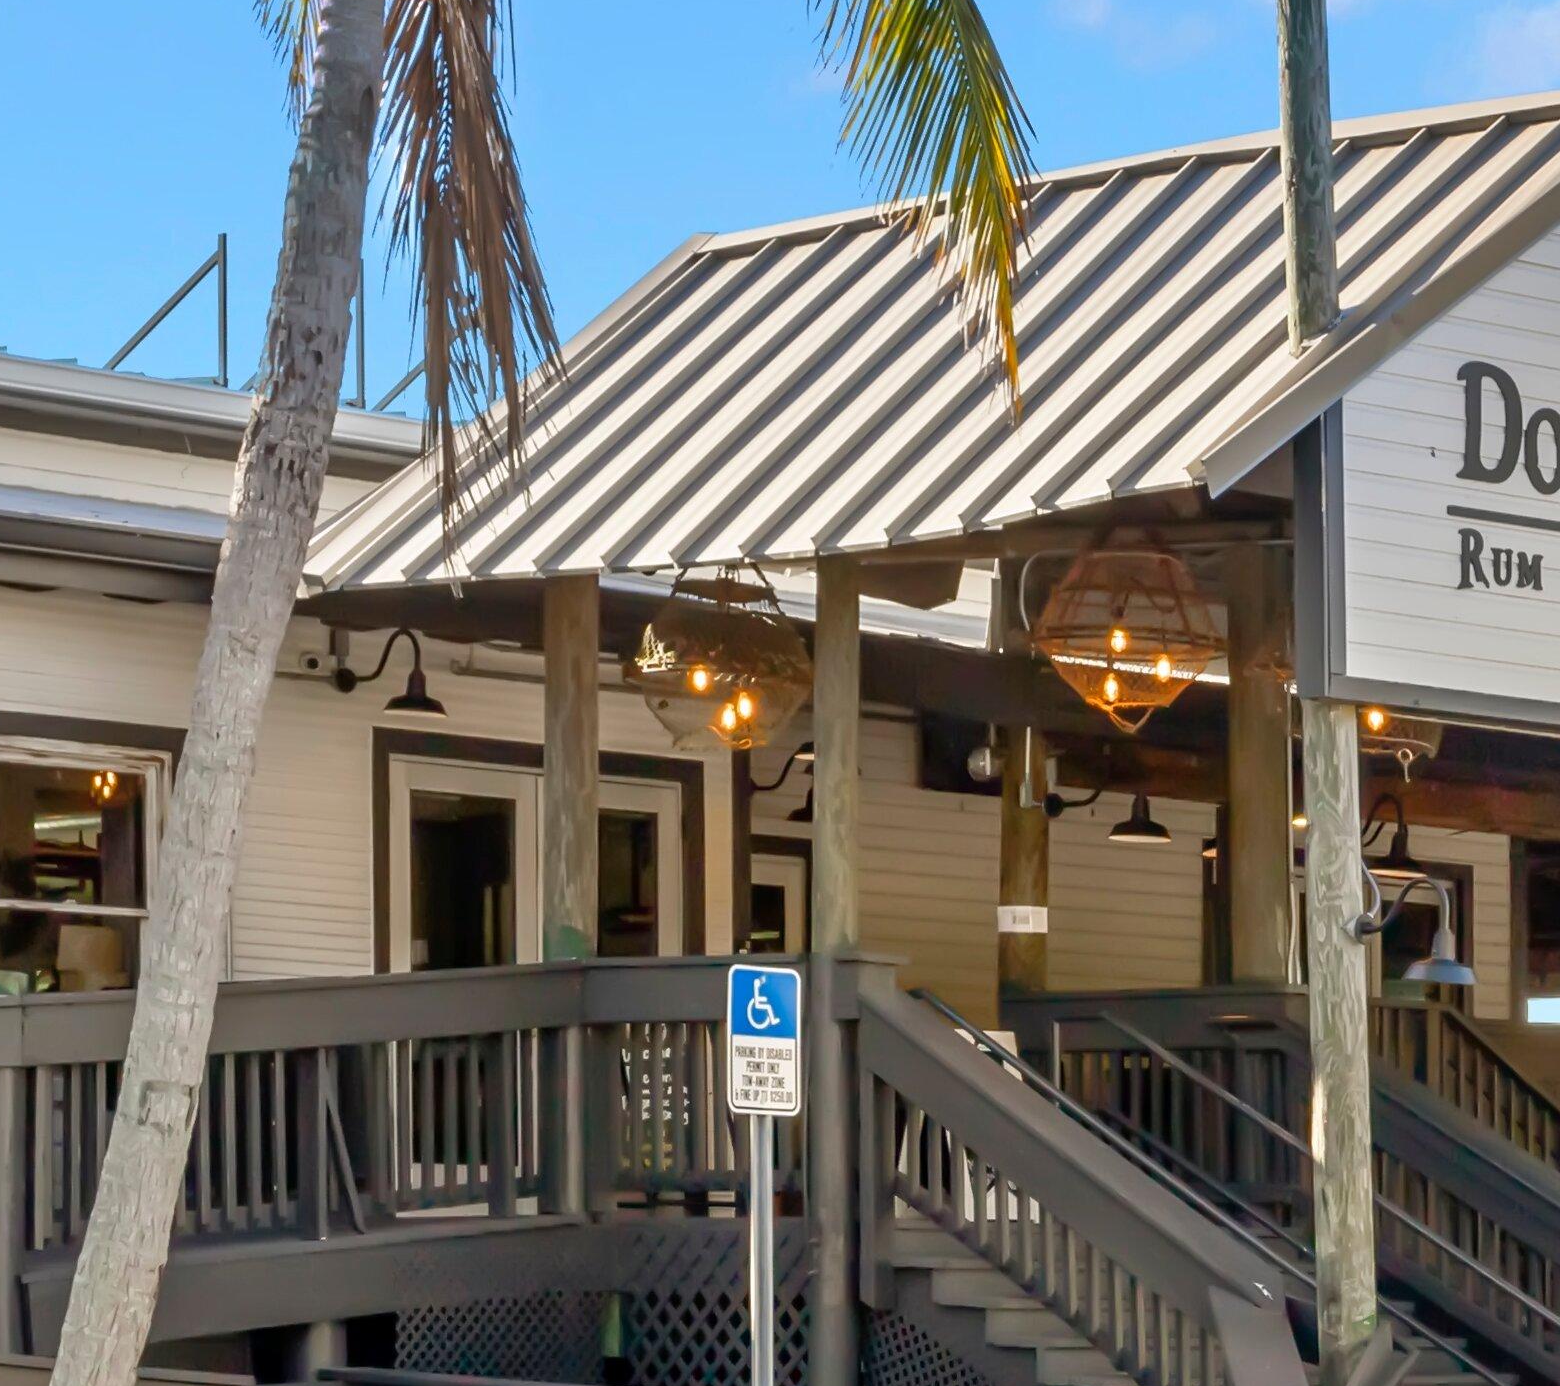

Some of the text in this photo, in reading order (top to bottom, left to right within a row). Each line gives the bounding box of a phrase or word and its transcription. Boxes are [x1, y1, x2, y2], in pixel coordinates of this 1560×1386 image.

[1456, 527, 1544, 591] RUM
[735, 1046, 756, 1059] PARKING
[766, 1048, 792, 1061] DISABLED
[746, 1060, 765, 1073] PERMIT
[771, 1076, 785, 1089] ZONE
